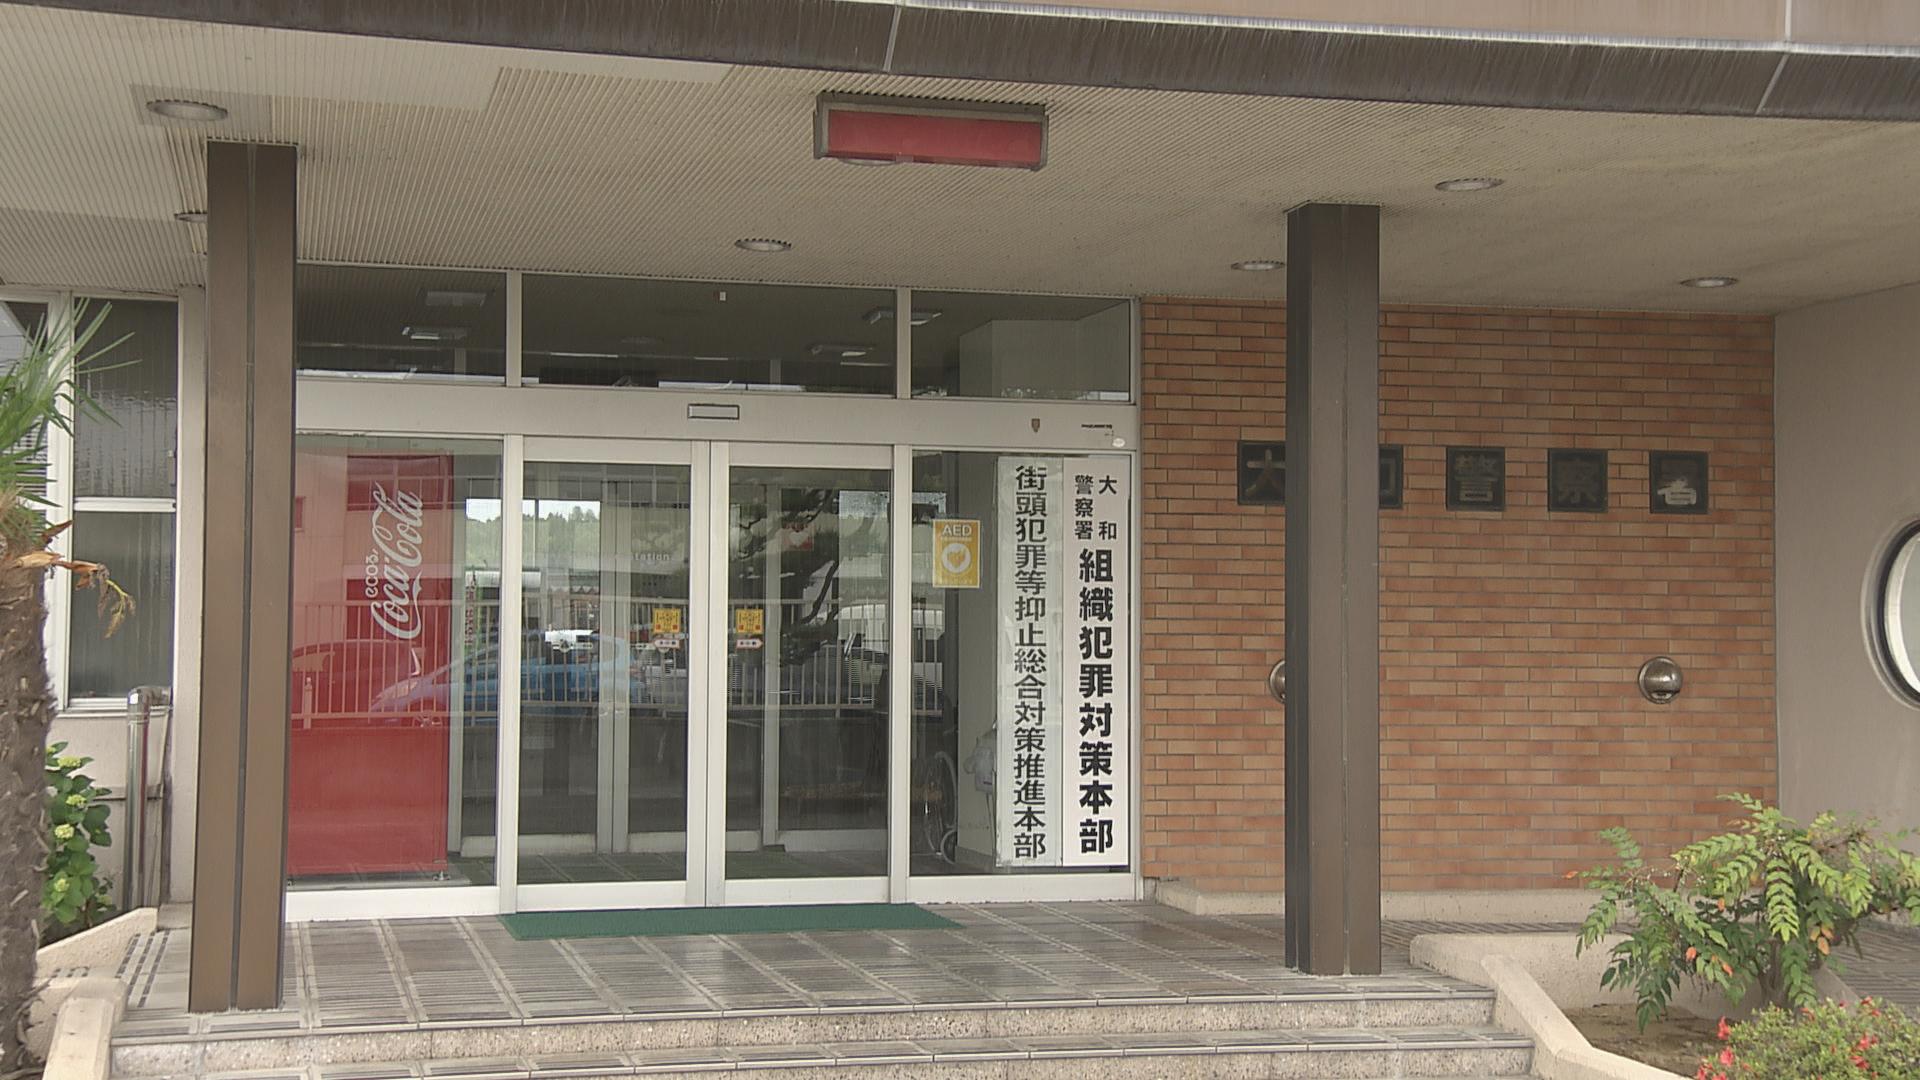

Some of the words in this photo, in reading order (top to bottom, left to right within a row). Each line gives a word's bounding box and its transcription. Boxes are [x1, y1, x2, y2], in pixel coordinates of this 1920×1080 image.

[371, 481, 423, 639] Coca-Cola
[942, 524, 972, 537] AED
[1074, 474, 1094, 541] 警察署
[1098, 475, 1117, 541] 大和
[1014, 465, 1047, 858] 街頭犯罪等抑止総合対策推進本部
[1079, 548, 1114, 854] 組織犯罪対策本部
